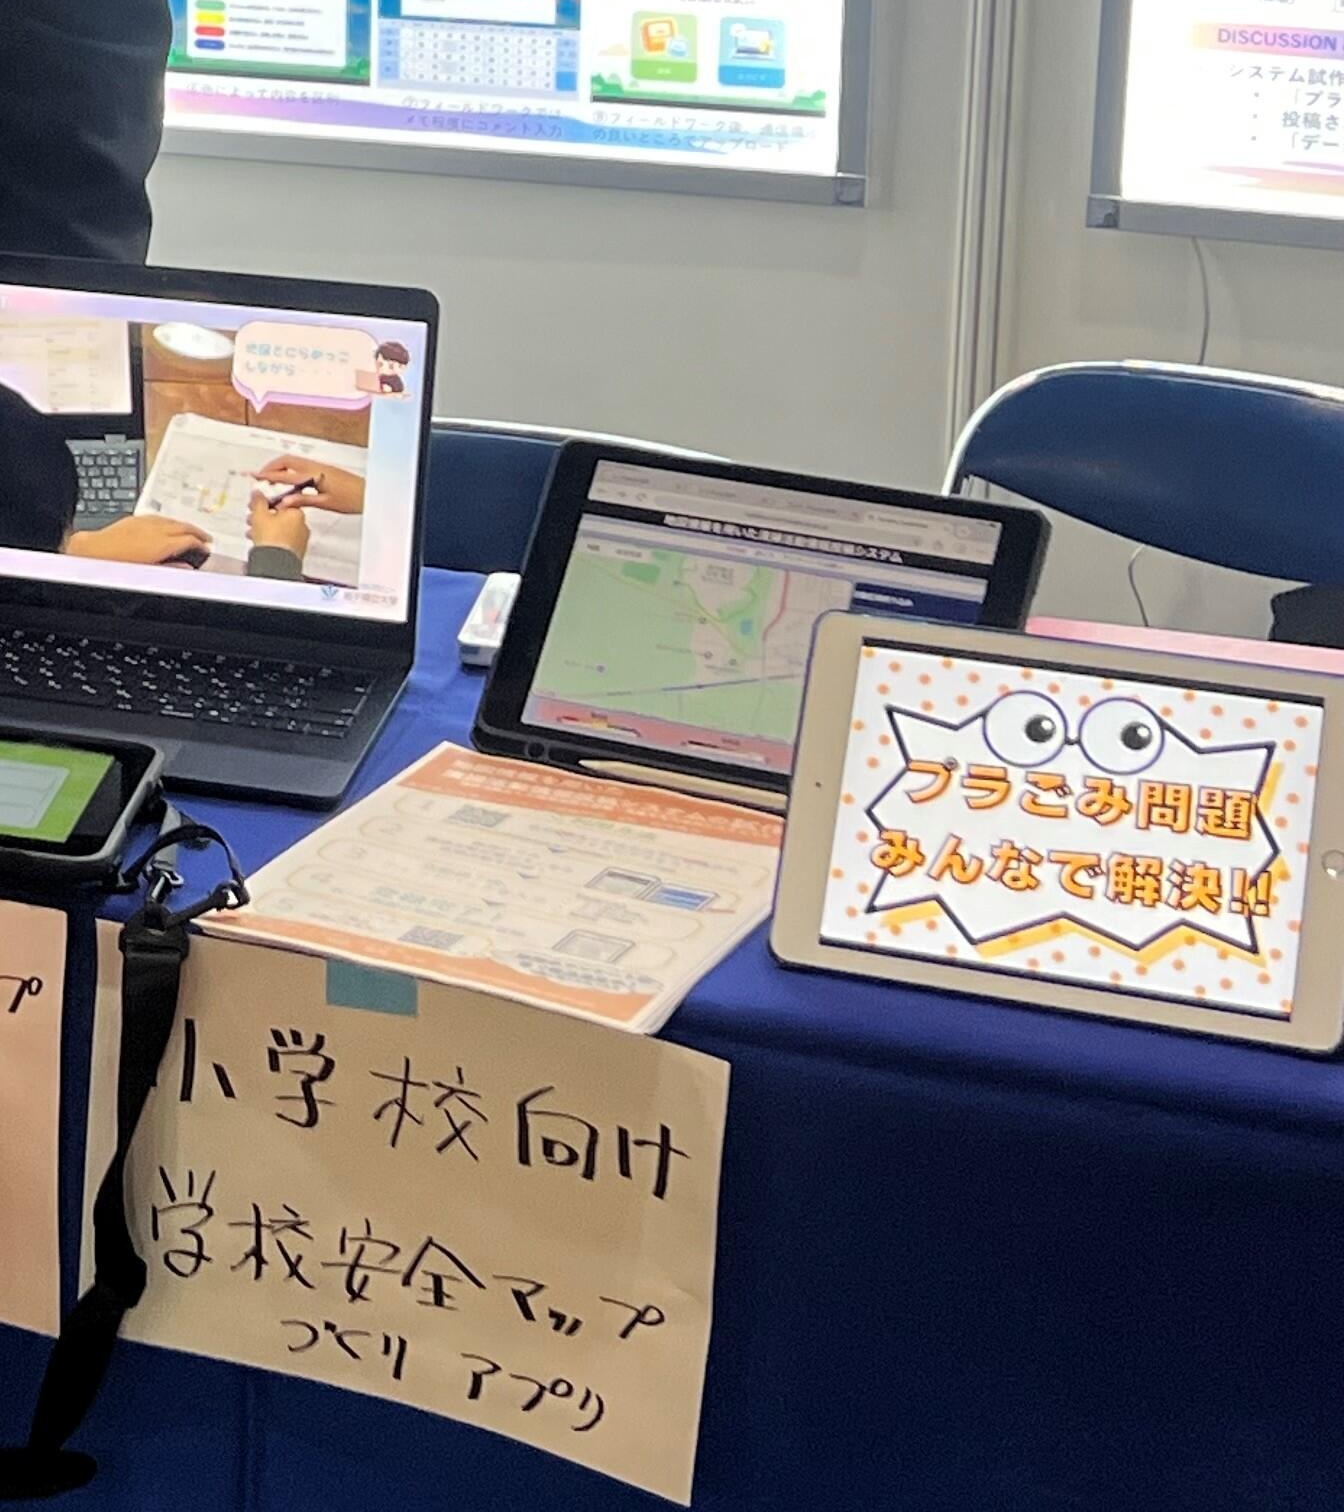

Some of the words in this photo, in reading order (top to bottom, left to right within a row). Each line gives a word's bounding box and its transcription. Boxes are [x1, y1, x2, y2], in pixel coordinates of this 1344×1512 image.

[1216, 27, 1338, 53] DISCUSSION
[904, 757, 1258, 841] プラごみ問題
[179, 1016, 692, 1200] 小学校向け
[150, 1165, 667, 1341] 学校安全マップ
[279, 1319, 409, 1381] づくり
[459, 1352, 607, 1433] アプリ
